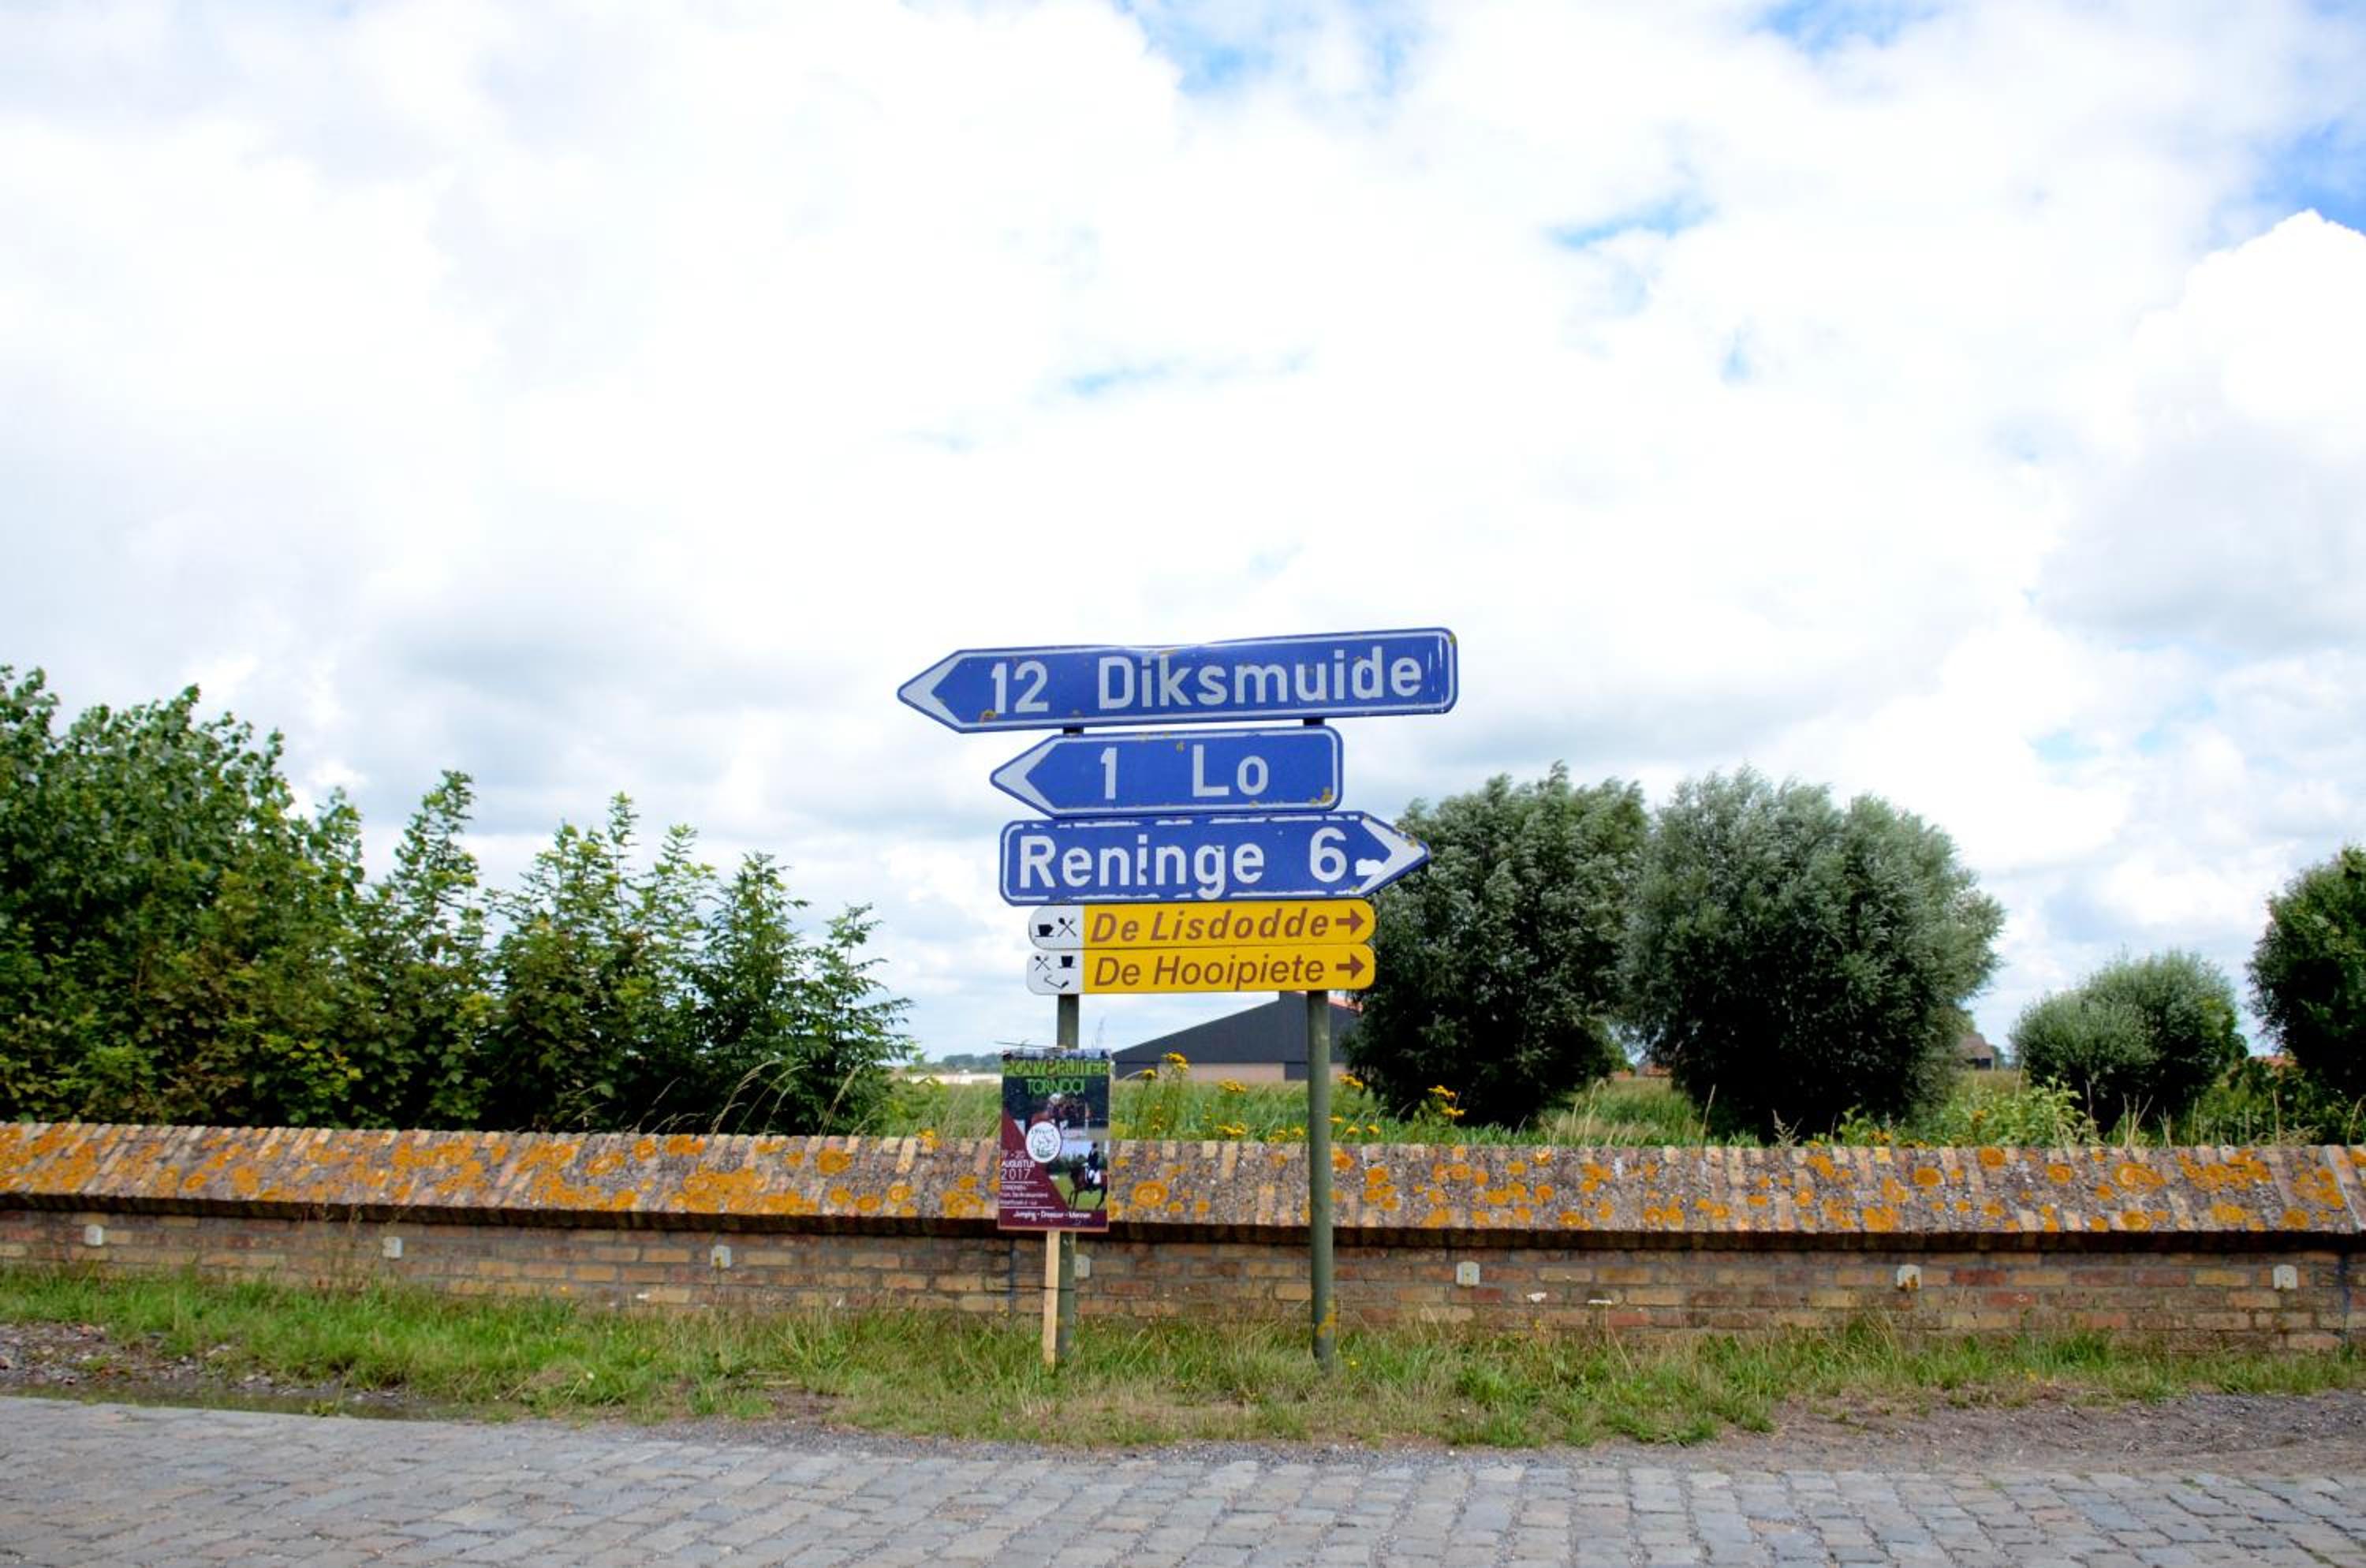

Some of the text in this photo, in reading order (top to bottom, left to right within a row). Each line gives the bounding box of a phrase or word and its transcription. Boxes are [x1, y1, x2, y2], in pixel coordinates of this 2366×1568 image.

[990, 645, 1422, 715] 12 Diksmuide
[1099, 744, 1269, 801] 1 Lo
[1019, 827, 1348, 900] Reninge 6
[1091, 905, 1329, 943] De Lisdodde
[1094, 953, 1325, 992] De Hooipiete
[1002, 1169, 1032, 1182] 2017
